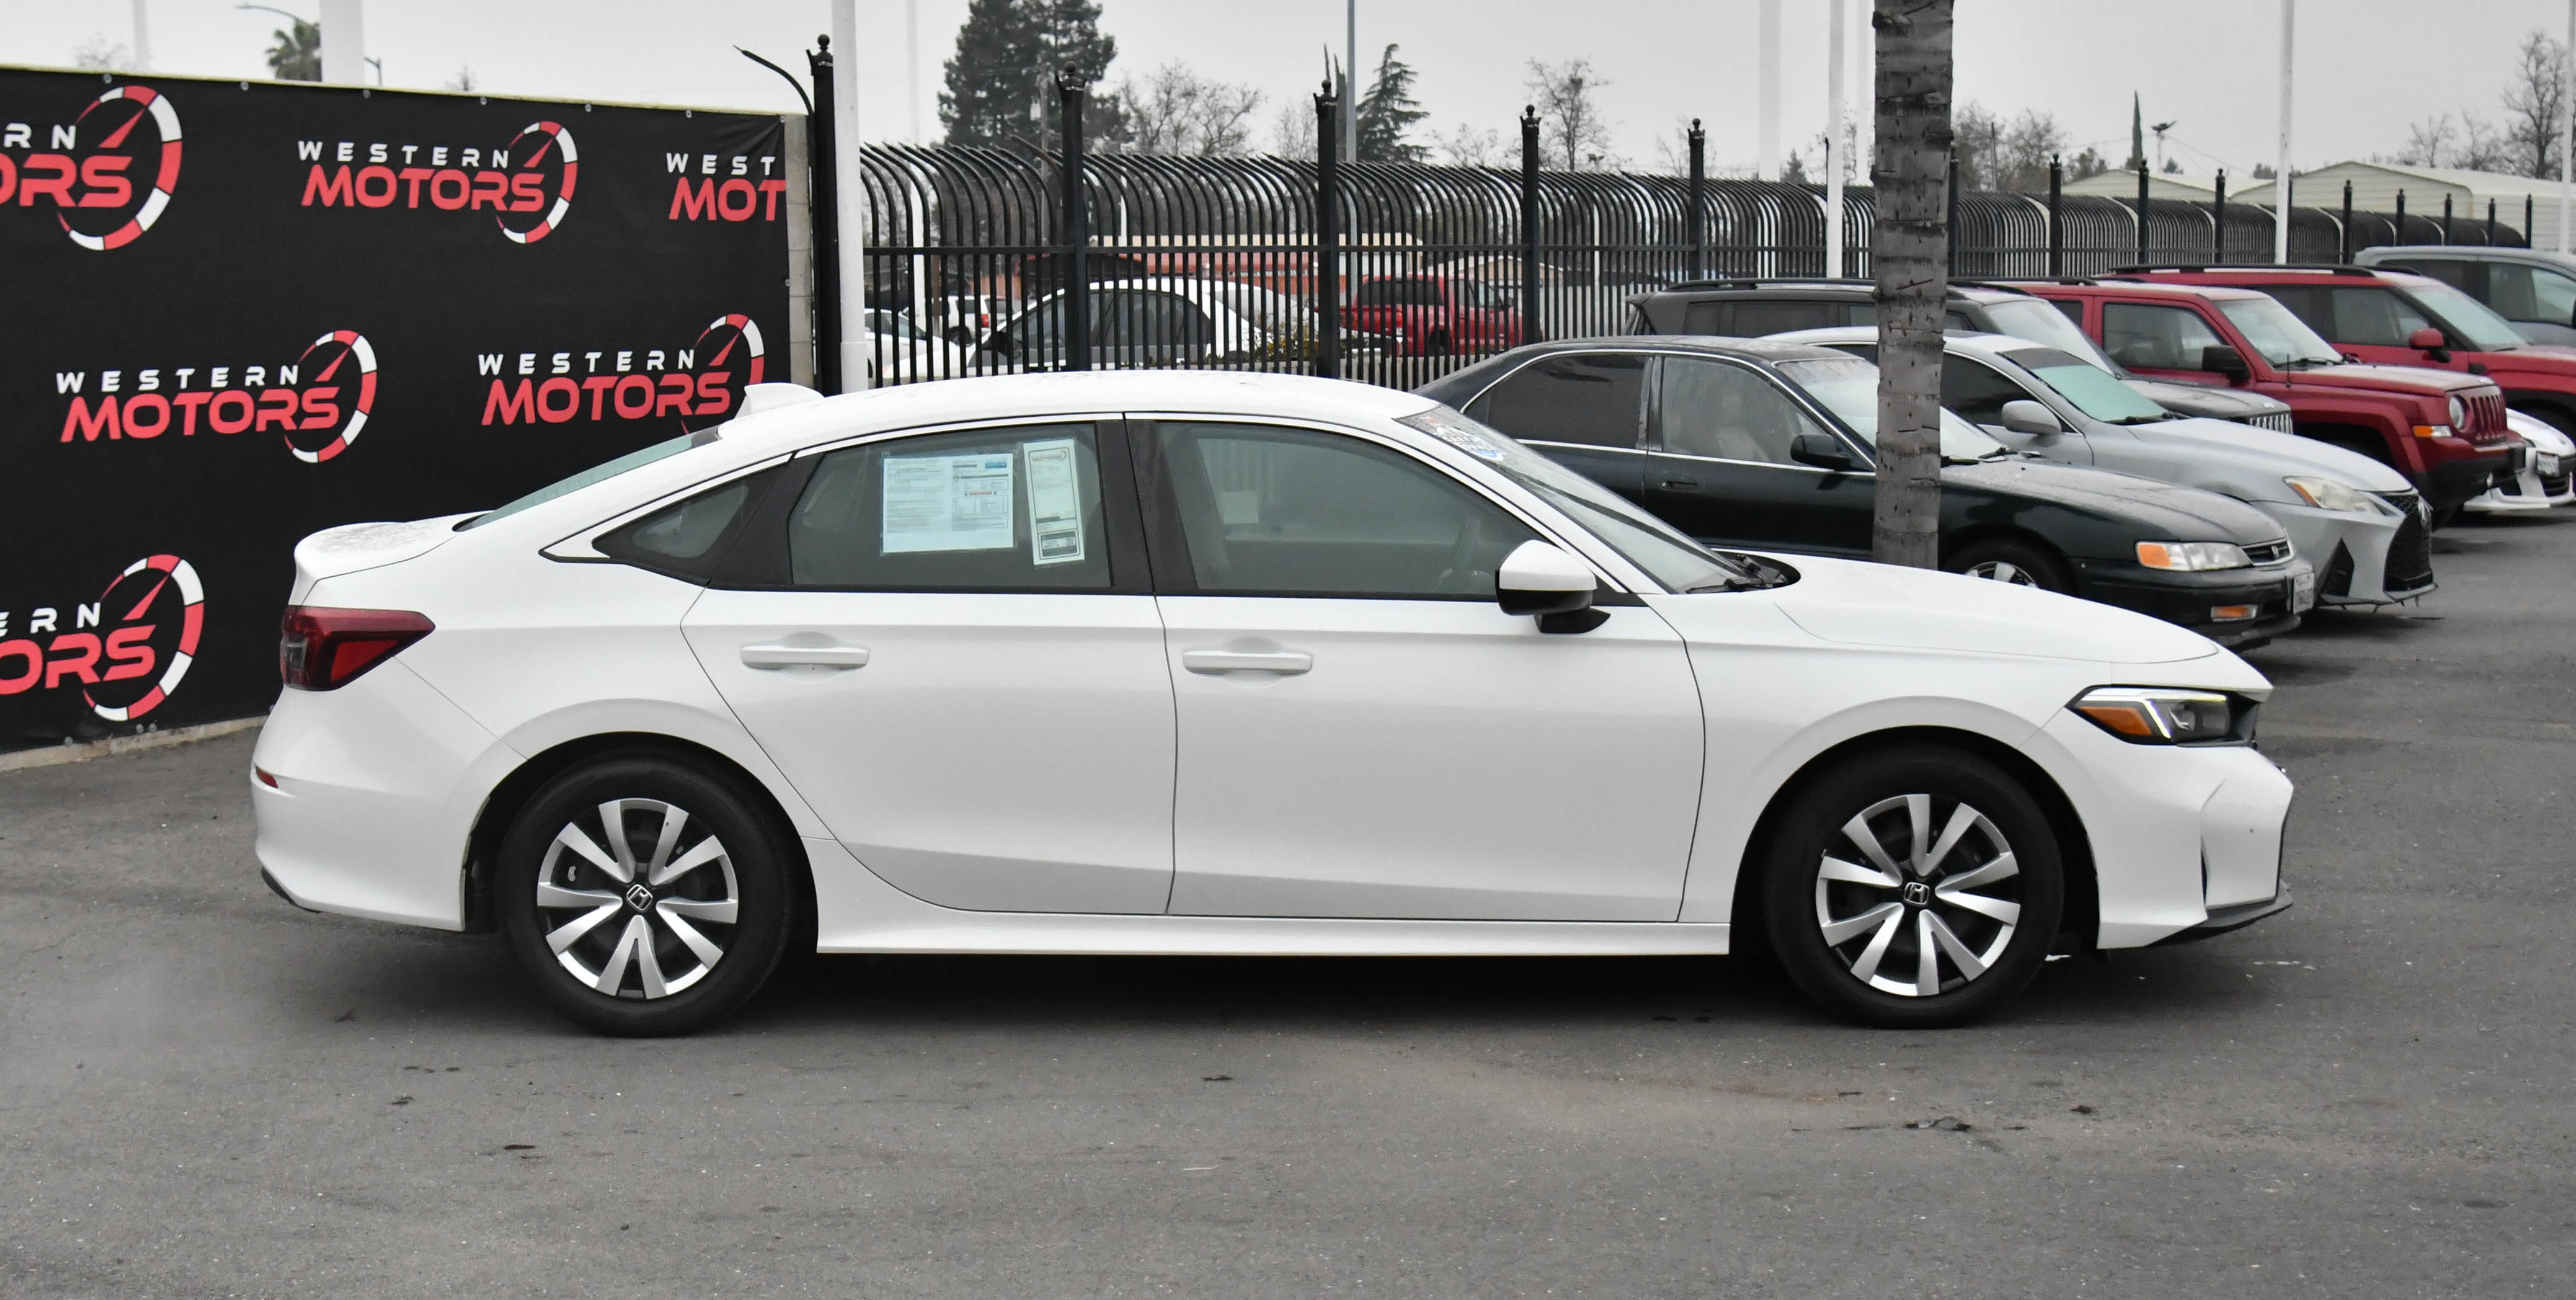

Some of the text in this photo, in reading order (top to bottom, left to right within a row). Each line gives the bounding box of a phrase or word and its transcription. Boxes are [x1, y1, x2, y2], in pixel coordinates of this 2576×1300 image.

[298, 140, 509, 169] WESTERN
[666, 153, 776, 176] WEST
[301, 164, 544, 212] MOTORS
[478, 349, 695, 376] WESTERN
[56, 365, 298, 394] WESTERN
[481, 372, 731, 426] MOTORS
[60, 386, 340, 443] MOTORS
